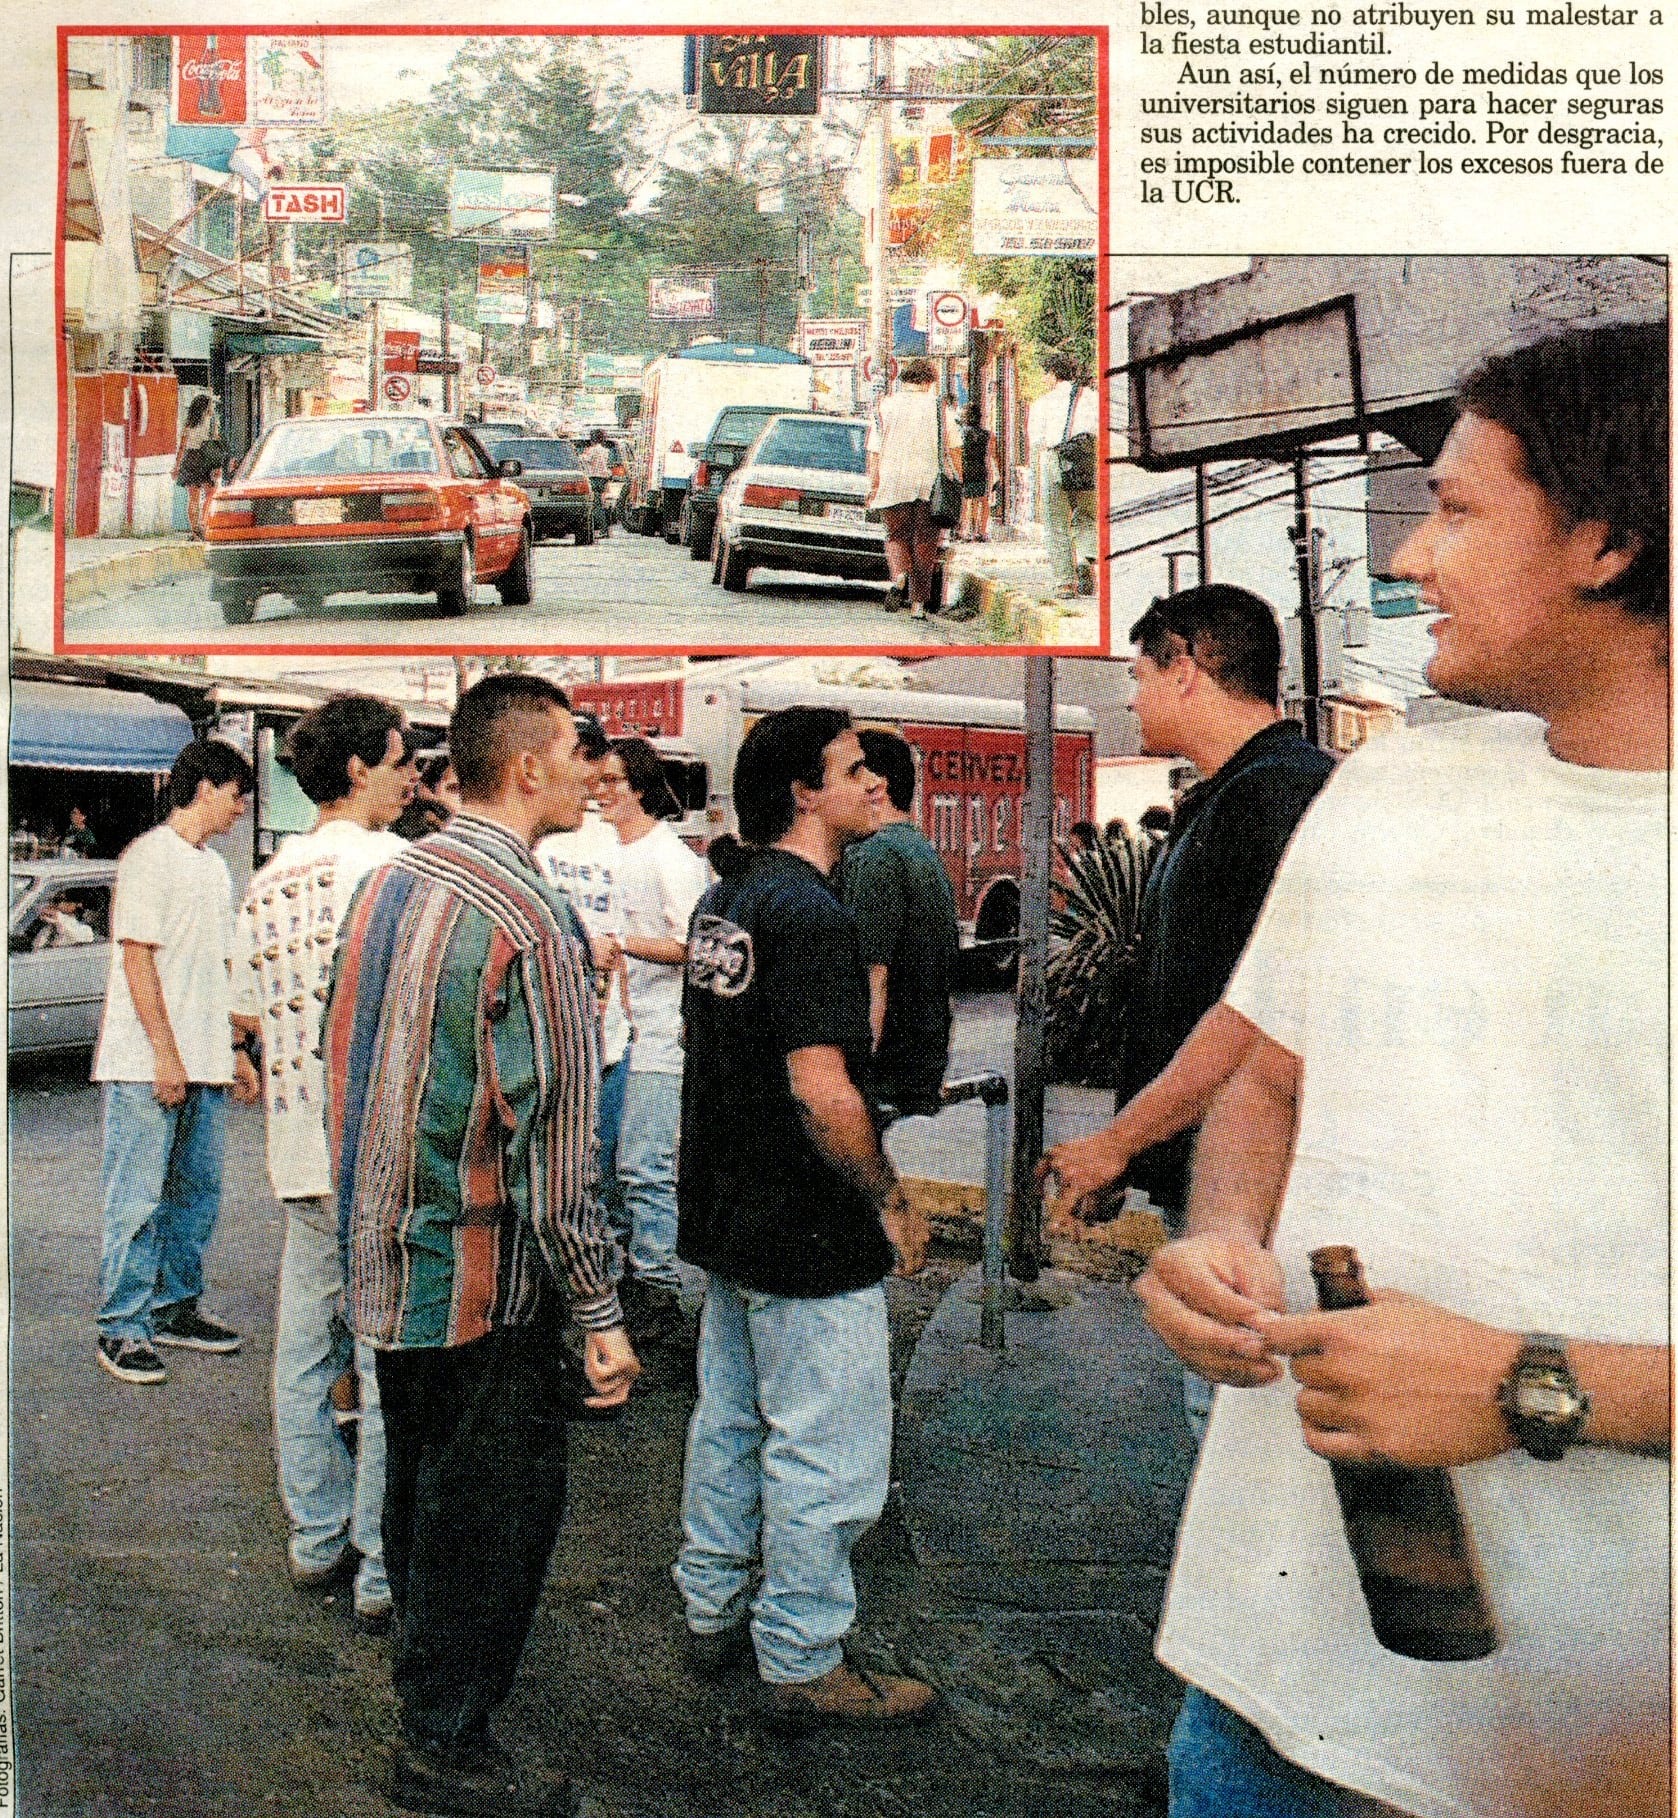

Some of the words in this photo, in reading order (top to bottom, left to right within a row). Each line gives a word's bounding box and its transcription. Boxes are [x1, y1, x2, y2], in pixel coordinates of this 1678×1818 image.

[1141, 2, 1195, 29] bles,
[1207, 10, 1299, 30] aunque
[1312, 10, 1341, 25] no
[1353, 2, 1475, 30] atribuyen
[1487, 10, 1515, 25] su
[1527, 2, 1638, 25] malestar
[1650, 10, 1663, 25] a
[1140, 32, 1163, 54] la
[1172, 32, 1240, 54] fiesta
[1250, 32, 1391, 54] estudiantil.
[1177, 62, 1230, 84] Aun
[1240, 63, 1281, 88] así,
[1290, 62, 1311, 84] el
[1320, 63, 1416, 84] número
[1425, 62, 1453, 84] de
[1463, 62, 1567, 84] medidas
[1576, 69, 1620, 89] que
[1630, 62, 1663, 84] los
[1141, 92, 1315, 114] universitarios
[1327, 92, 1408, 119] siguen
[1420, 99, 1476, 119] para
[1487, 91, 1557, 114] hacer
[1568, 99, 1663, 119] seguras
[1141, 128, 1182, 143] sus
[1192, 121, 1332, 144] actividades
[1342, 121, 1374, 143] ha
[1384, 121, 1475, 143] crecido.
[1486, 121, 1528, 144] Por
[1538, 121, 1662, 149] desgracia,
[1141, 158, 1166, 173] es
[1174, 151, 1294, 179] imposible
[1303, 153, 1411, 173] contener
[1419, 151, 1452, 173] los
[1462, 158, 1553, 174] excesos
[1561, 151, 1627, 174] fuera
[1635, 151, 1663, 173] de
[271, 193, 339, 214] TASH
[1141, 180, 1164, 203] la
[1173, 180, 1240, 203] UCR.
[929, 750, 1027, 784] CERVEZ
